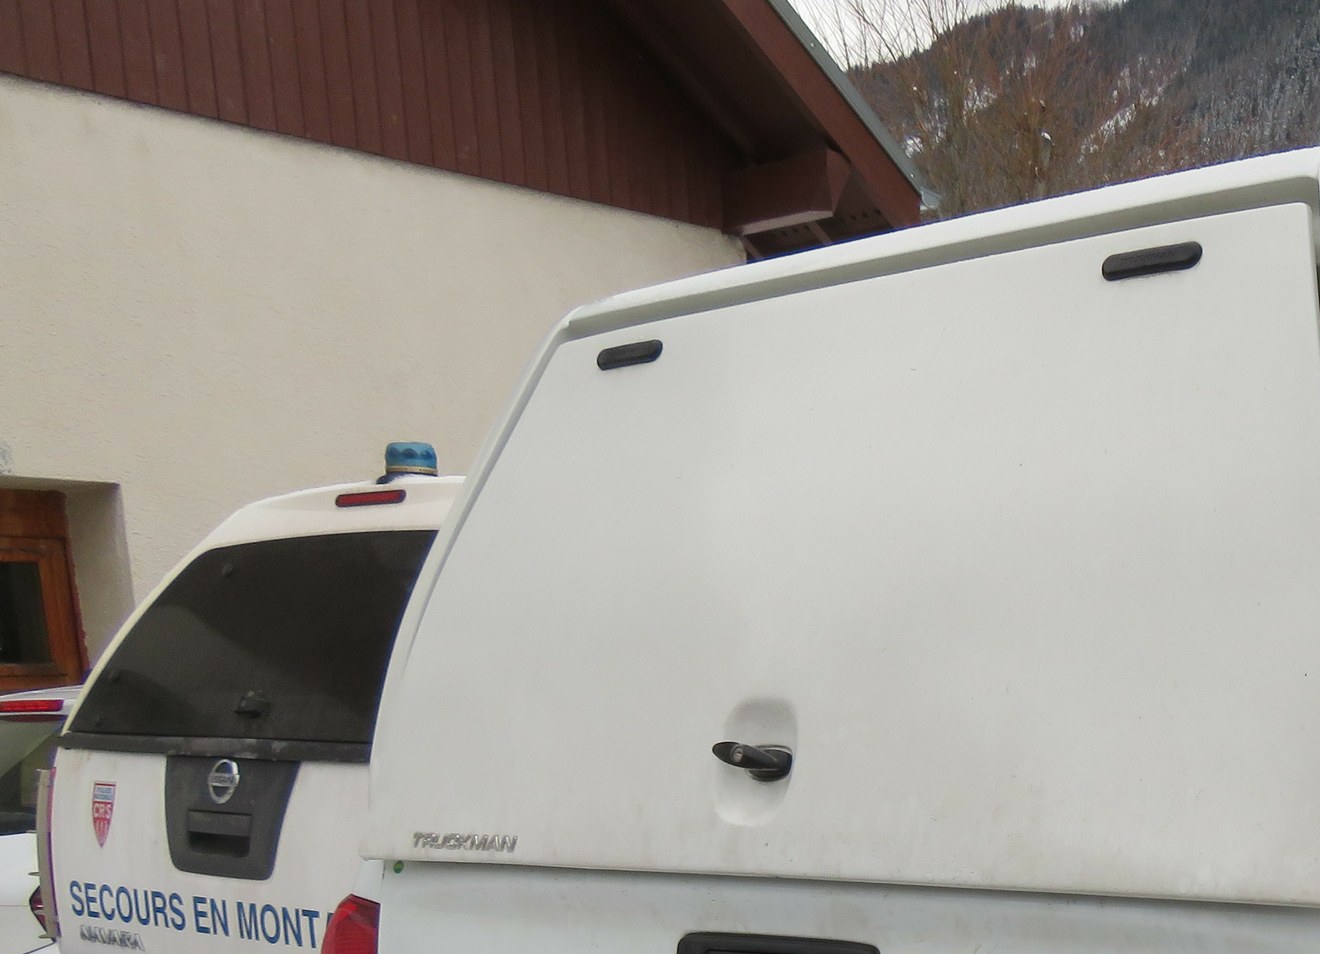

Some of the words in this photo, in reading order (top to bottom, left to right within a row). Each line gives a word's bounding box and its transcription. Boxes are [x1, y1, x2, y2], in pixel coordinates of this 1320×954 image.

[94, 802, 112, 819] CRS
[413, 832, 518, 853] TRUCKMAN
[69, 880, 187, 931] SECOURS
[193, 896, 230, 937] EN
[236, 901, 334, 949] MONT
[79, 924, 145, 951] NAVARA
